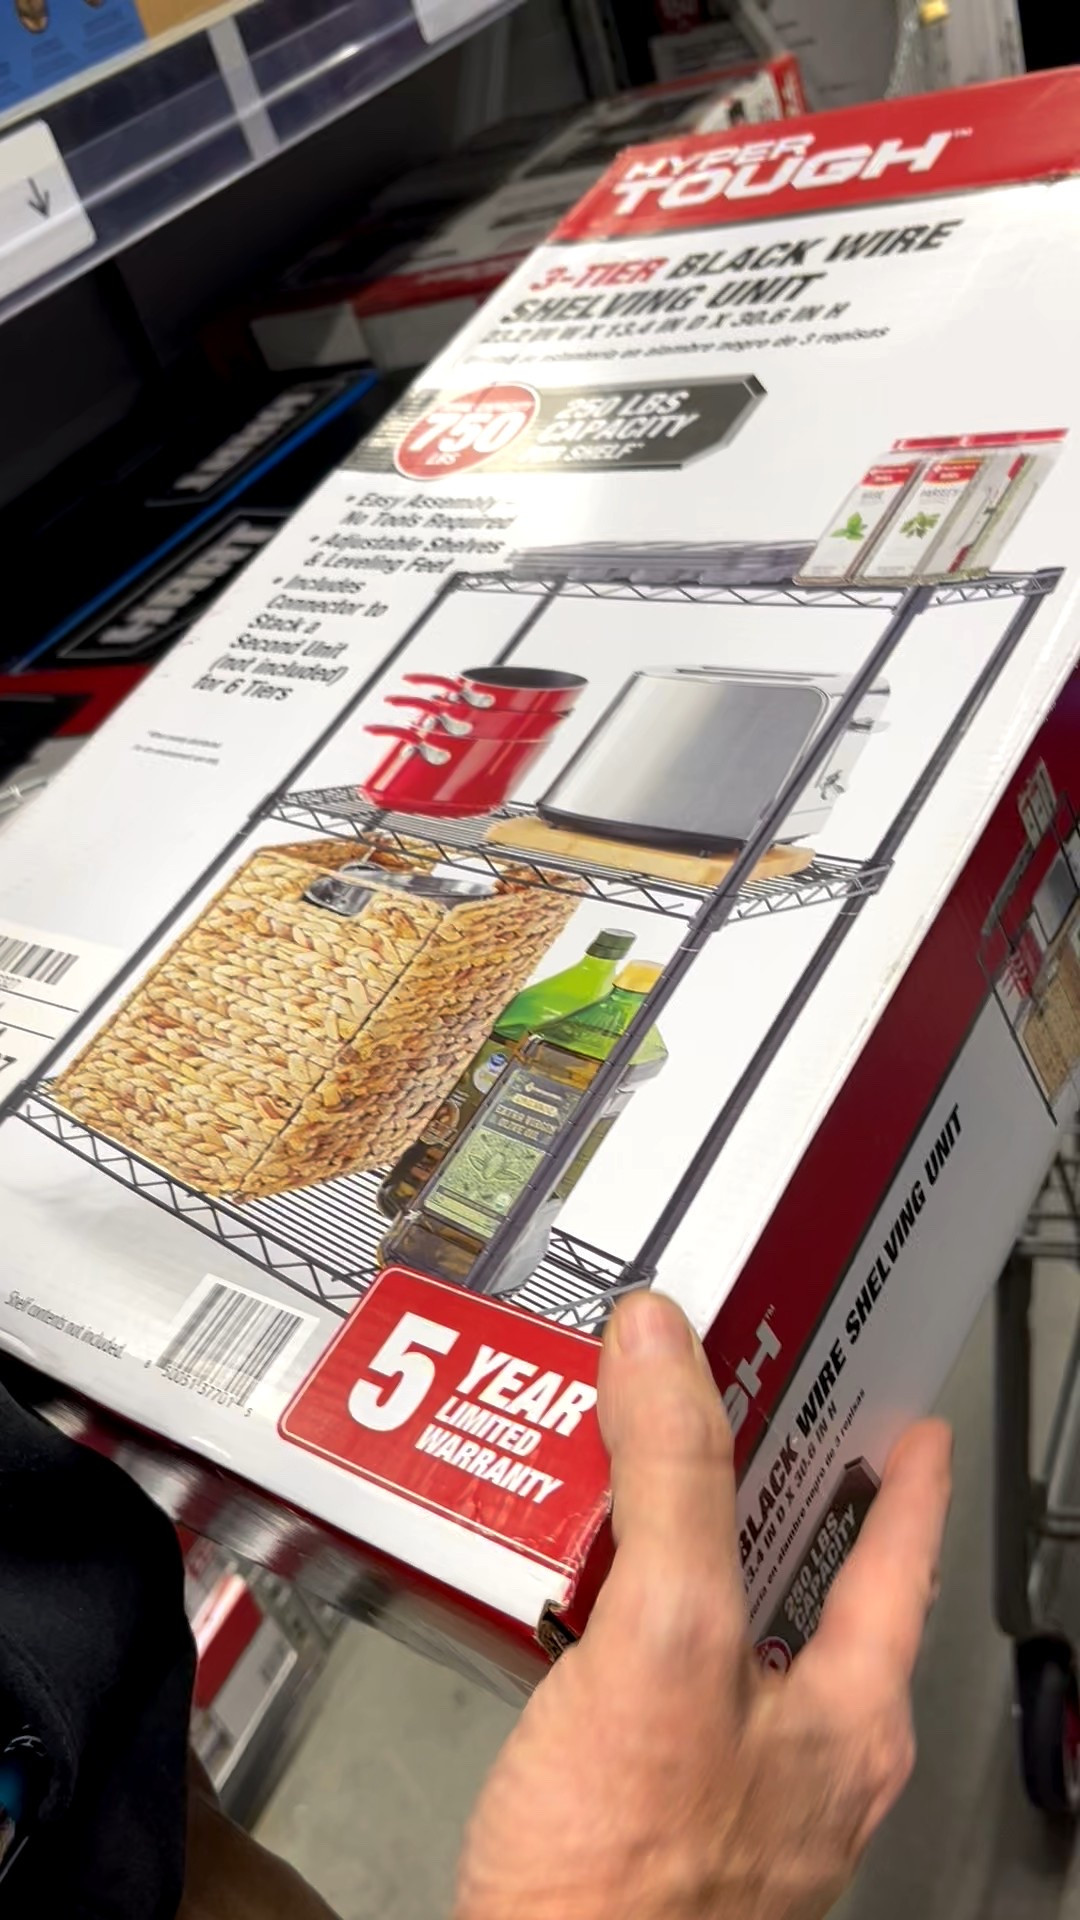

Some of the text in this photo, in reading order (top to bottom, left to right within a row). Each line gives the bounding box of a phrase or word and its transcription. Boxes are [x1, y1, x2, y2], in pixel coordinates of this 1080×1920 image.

[623, 132, 815, 179] HYPER
[612, 130, 952, 217] TOUGH
[530, 256, 669, 291] 3-TIER
[666, 237, 826, 281] BLACK
[823, 218, 964, 262] WIRE
[500, 272, 828, 324] SHELVING UNIT
[556, 396, 620, 420] 250
[617, 390, 689, 417] LBS
[408, 411, 526, 454] 750
[537, 413, 700, 445] CAPACITY
[357, 492, 404, 511] Easy
[340, 510, 368, 526] No
[370, 511, 424, 527] Tools
[319, 533, 506, 553] Adjustable Shelves
[303, 551, 325, 567] &
[404, 556, 455, 573] Feet
[283, 575, 367, 594] Includes
[266, 593, 389, 618] Connector to
[247, 612, 322, 634] Stack a
[229, 632, 349, 659] Second Unit
[208, 652, 349, 687] (not included)
[191, 672, 294, 701] for 6 Tiers
[739, 1432, 799, 1569] BLACK
[795, 1337, 847, 1439] WIRE
[845, 1179, 928, 1345] SHELVING
[924, 1101, 963, 1186] UNIT
[347, 1310, 462, 1433] 5
[454, 1343, 599, 1438] YEAR
[433, 1395, 543, 1458] LIMITED
[814, 1417, 829, 1445] IN
[414, 1423, 565, 1505] WARRANTY
[809, 1510, 839, 1567] LBS
[794, 1502, 857, 1633] CAPACITY
